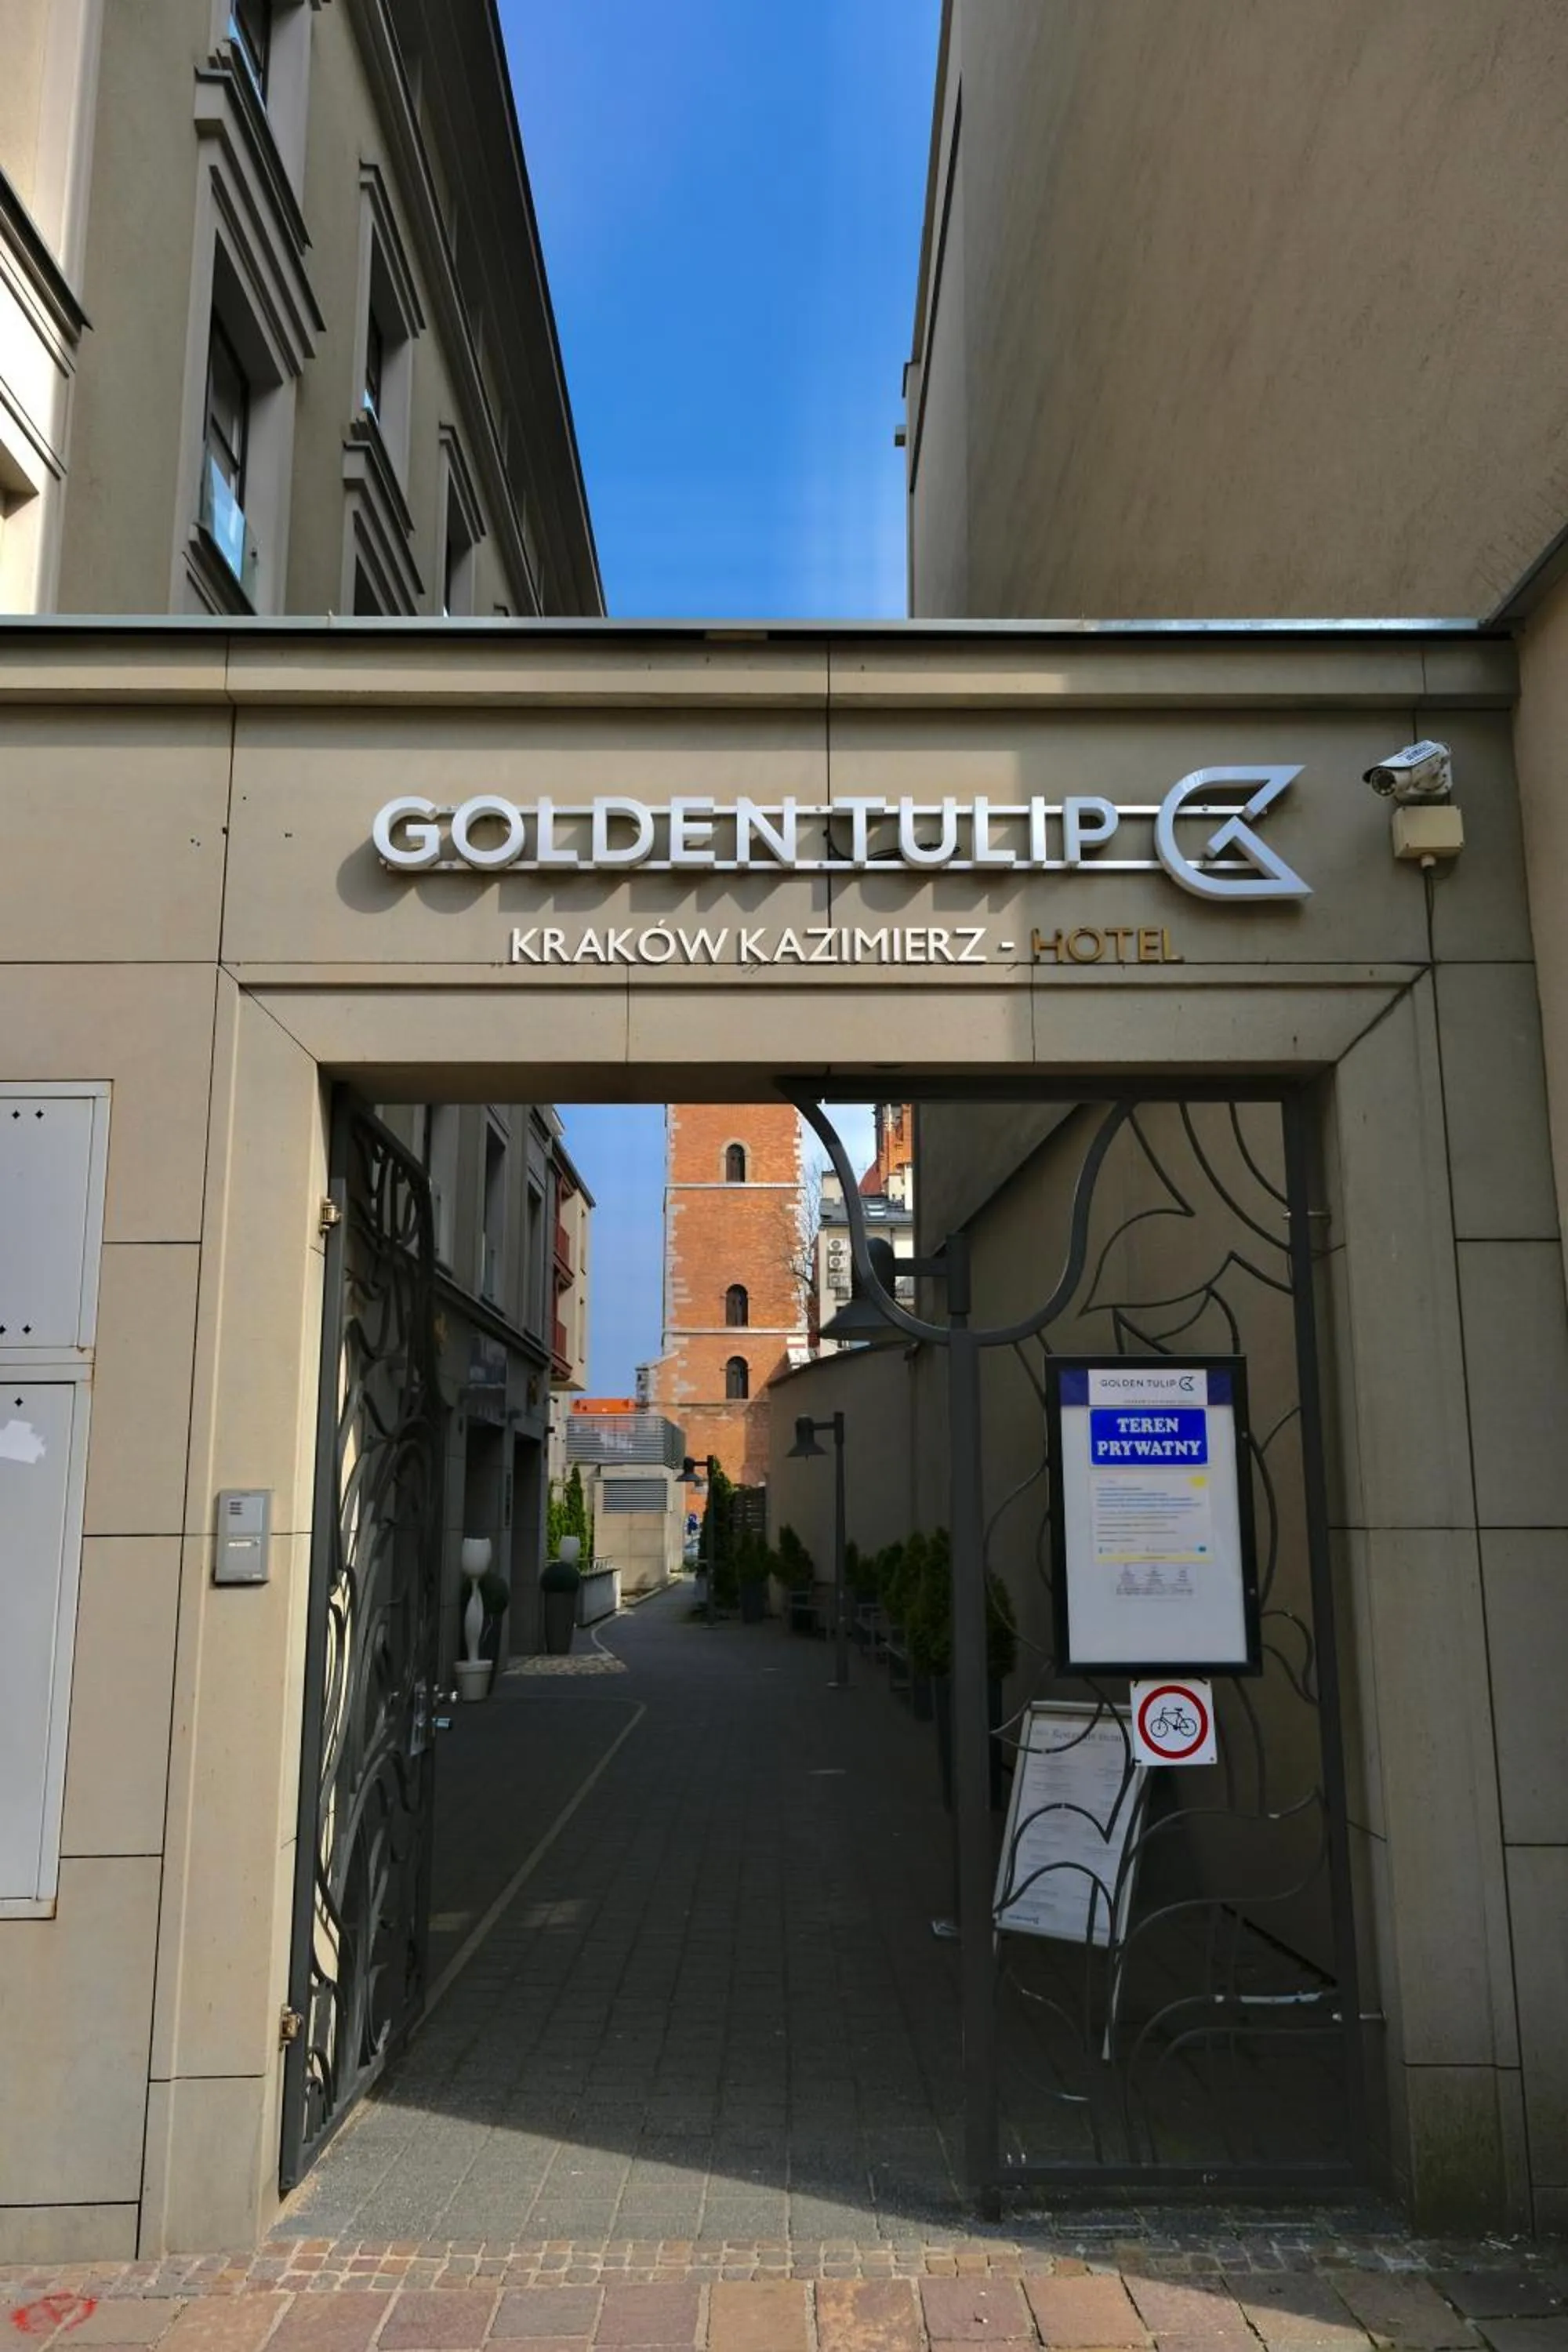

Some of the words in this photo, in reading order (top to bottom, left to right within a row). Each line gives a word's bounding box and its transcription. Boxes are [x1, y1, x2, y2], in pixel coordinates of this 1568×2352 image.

[372, 795, 797, 869] GOLDEN
[833, 796, 1120, 868] TULIP
[510, 918, 729, 964] KRAKÓW
[739, 927, 988, 964] KAZIMIERZ
[1031, 926, 1185, 964] HOTEL
[1100, 1378, 1144, 1388] GOLDEN
[1147, 1378, 1177, 1388] TULIP
[1116, 1417, 1179, 1434] TEREN
[1097, 1440, 1202, 1457] PRYWATNY
